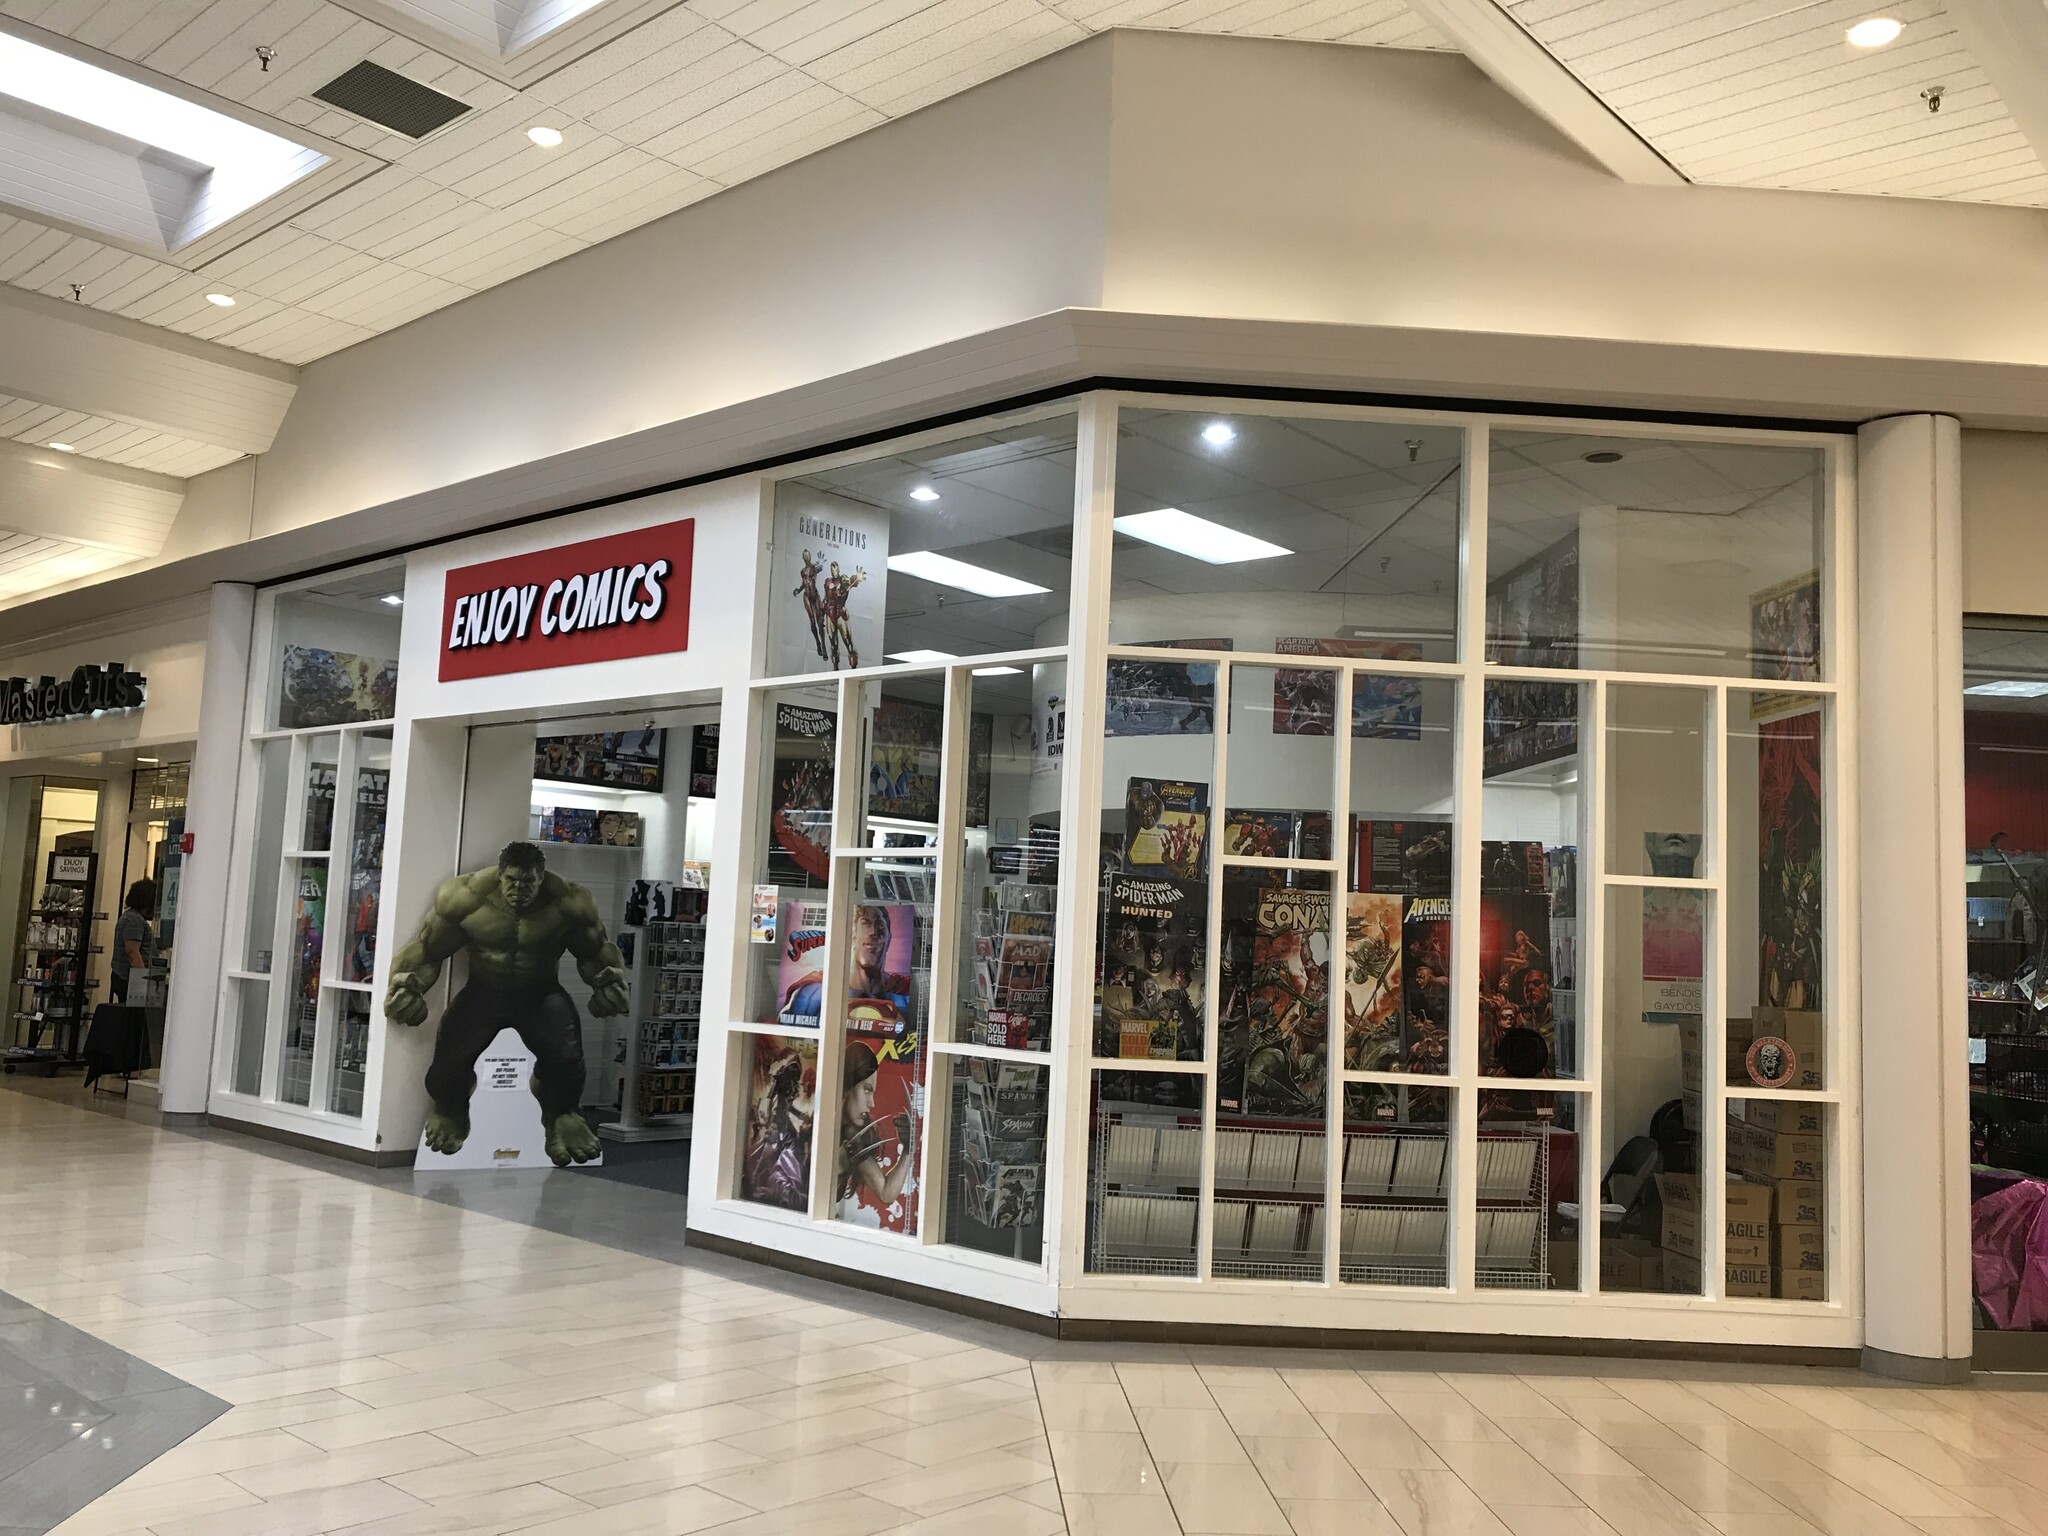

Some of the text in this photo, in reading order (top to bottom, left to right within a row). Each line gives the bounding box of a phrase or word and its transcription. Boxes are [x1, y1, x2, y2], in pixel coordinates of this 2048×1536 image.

[799, 516, 867, 550] GENERATIONS
[448, 559, 672, 650] ENJOY COMICS
[1281, 638, 1316, 646] CAPTAIN
[1276, 643, 1320, 655] AMERICA
[790, 707, 824, 721] AMAZING
[59, 865, 85, 873] SAVINGS
[1130, 880, 1172, 892] AMAZING
[1265, 892, 1303, 904] SAVAGE
[1121, 906, 1173, 919] HUNTED
[1403, 897, 1451, 923] AVENGE
[1011, 944, 1042, 958] MAD
[1013, 991, 1047, 1003] DECADES
[1660, 988, 1702, 998] BENDIS
[1653, 1001, 1702, 1012] GAYDOS
[795, 1015, 818, 1026] MICHAEL
[987, 1022, 1008, 1035] SOLD
[1121, 1022, 1148, 1033] MARVEL
[987, 1033, 1007, 1046] HERE
[1121, 1034, 1148, 1046] SOLD
[1121, 1046, 1147, 1057] HERE
[1000, 1091, 1036, 1102] SPAWN
[999, 1118, 1035, 1133] SPAWN
[1746, 1130, 1775, 1151] FRAGILE
